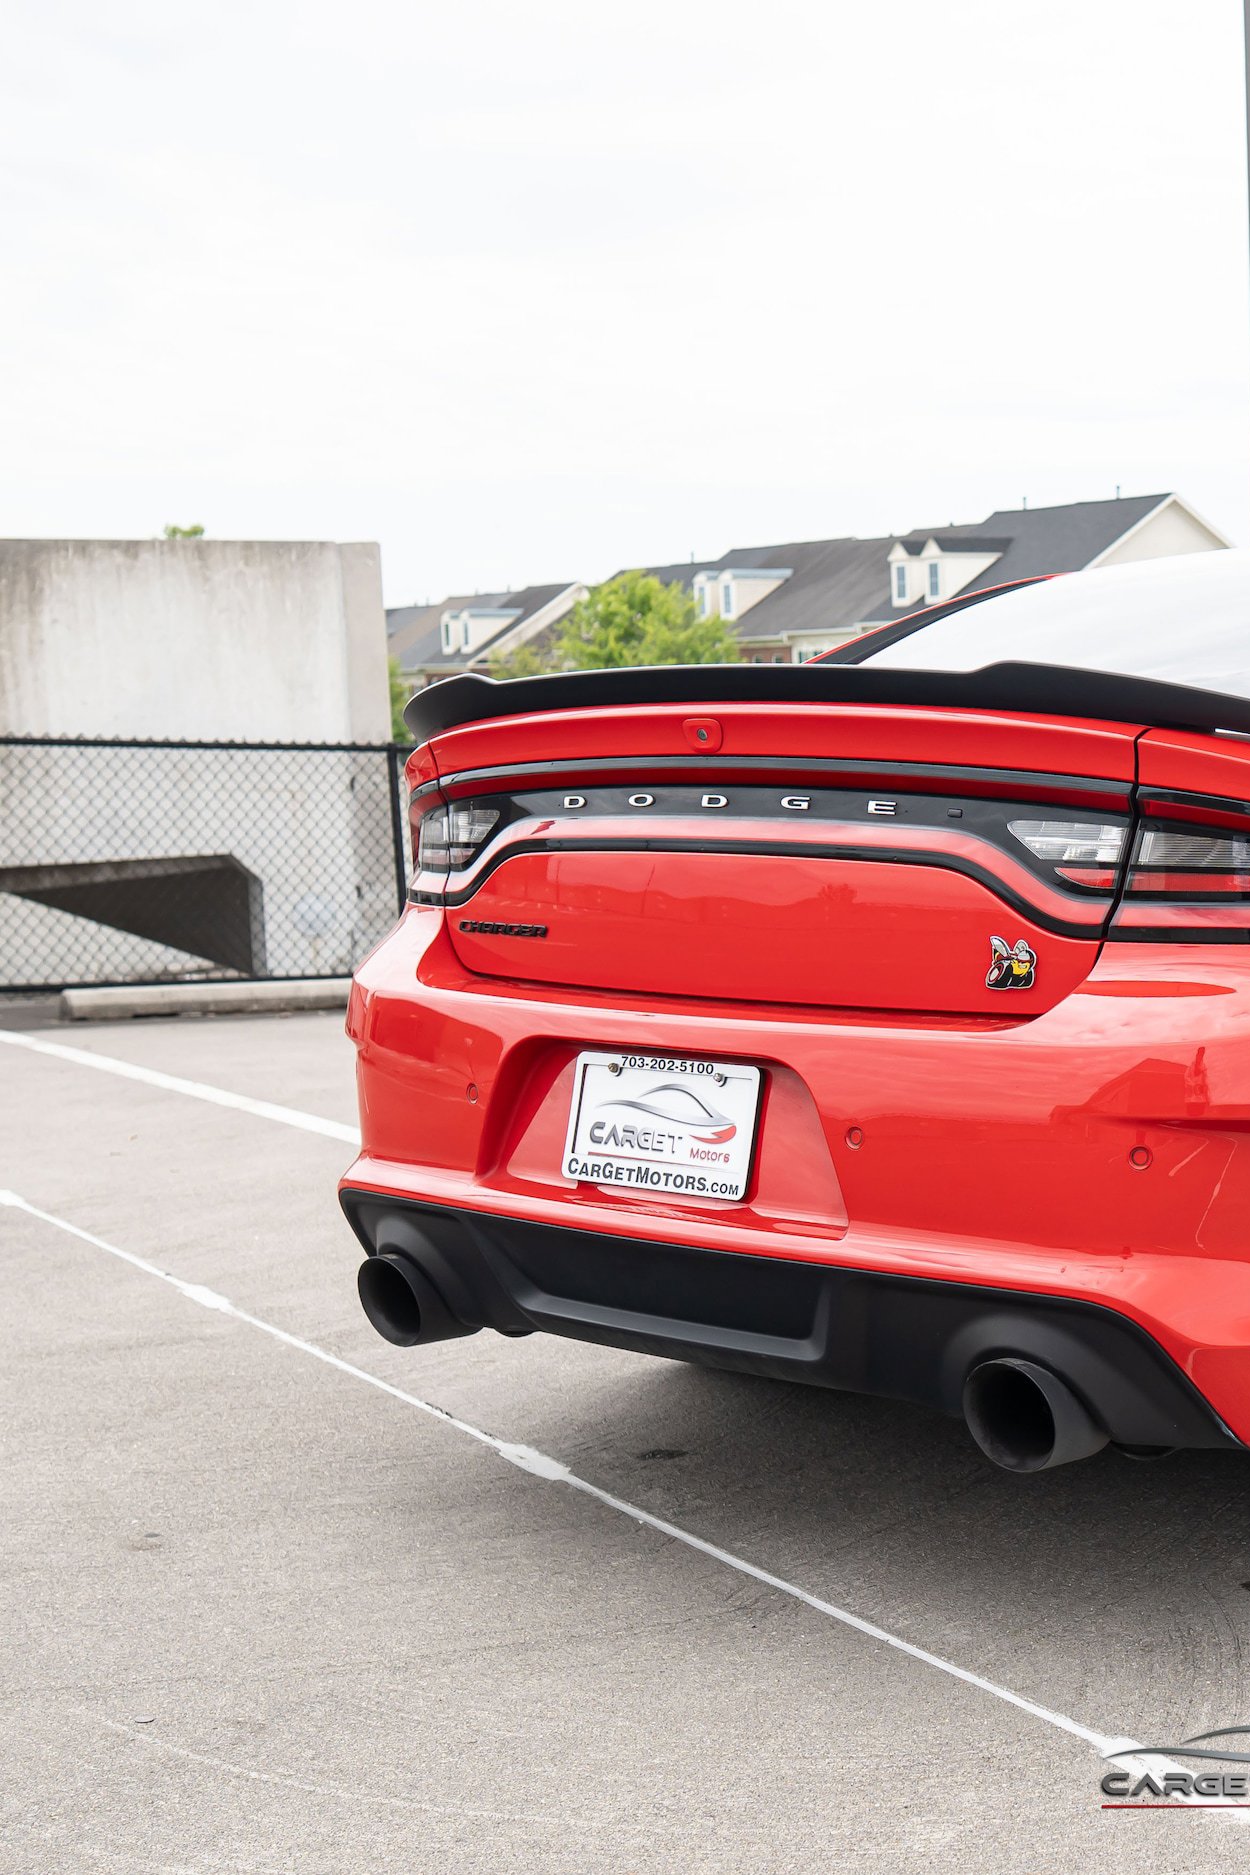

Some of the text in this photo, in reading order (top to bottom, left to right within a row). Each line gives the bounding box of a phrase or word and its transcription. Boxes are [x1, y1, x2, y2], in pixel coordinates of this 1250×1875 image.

[563, 793, 897, 815] DODGE
[459, 920, 548, 938] CHARGER
[621, 1056, 714, 1075] 703-202-5100
[589, 1121, 731, 1164] CARGET Motors
